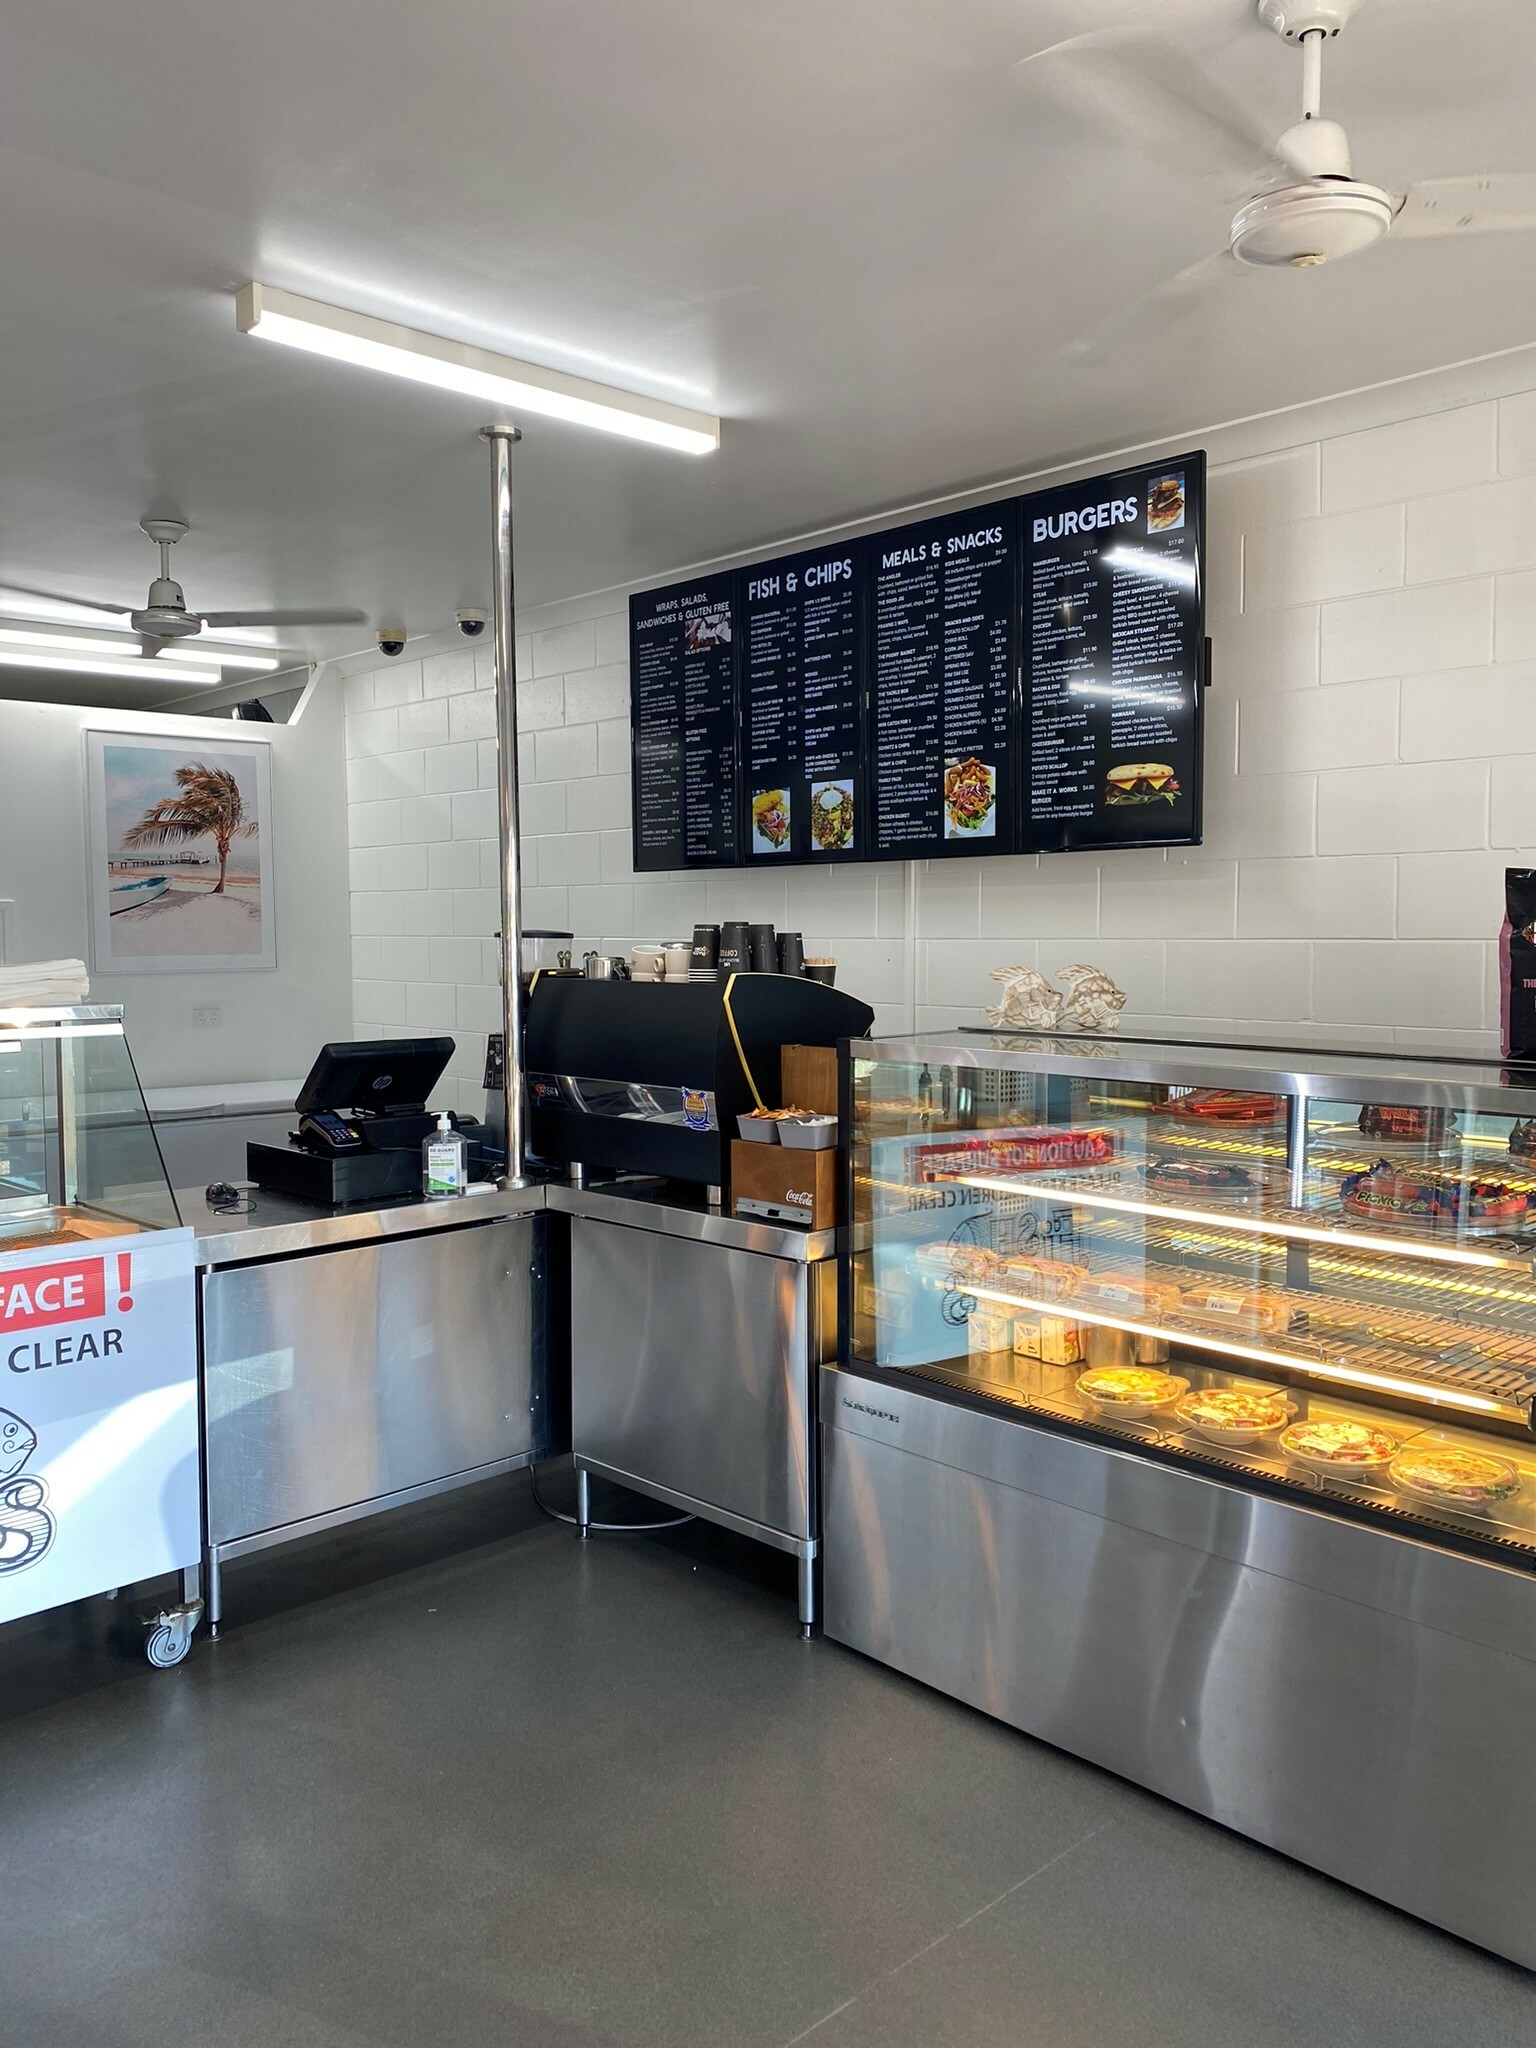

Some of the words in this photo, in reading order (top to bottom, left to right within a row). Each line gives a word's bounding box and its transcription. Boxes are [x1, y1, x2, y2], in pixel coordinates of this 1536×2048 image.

[1033, 496, 1138, 543] BURGERS
[882, 545, 926, 569] MEALS
[931, 541, 942, 557] &
[947, 526, 1003, 554] SNACKS
[1169, 538, 1184, 546] $17.00
[748, 576, 780, 601] FISH
[786, 572, 798, 592] &
[804, 558, 853, 587] CHIPS
[1033, 591, 1047, 599] STEAK
[1113, 589, 1130, 598] CHEESY
[1131, 583, 1163, 595] SMOKEHOUSE
[656, 600, 679, 612] WRAPS,
[681, 593, 708, 607] SALADS,
[636, 613, 676, 630] SANDWICHES
[678, 612, 683, 621] &
[685, 605, 712, 619] GLUTEN
[714, 601, 730, 613] FREE
[1112, 629, 1133, 639] MEXICAN
[1134, 625, 1159, 635] STEAKOUT
[1168, 620, 1184, 629] $17.00
[1112, 677, 1132, 686] CHICKEN
[1133, 672, 1162, 683] PARMIGIANA
[1032, 788, 1046, 797] MAKE
[1058, 785, 1078, 795] WORKS
[1031, 796, 1052, 806] BURGER
[1396, 1168, 1445, 1186] PICNIC
[1356, 1190, 1402, 1209] PICNIC
[0, 1273, 86, 1319] ACE
[7, 1328, 124, 1374] CLEAR
